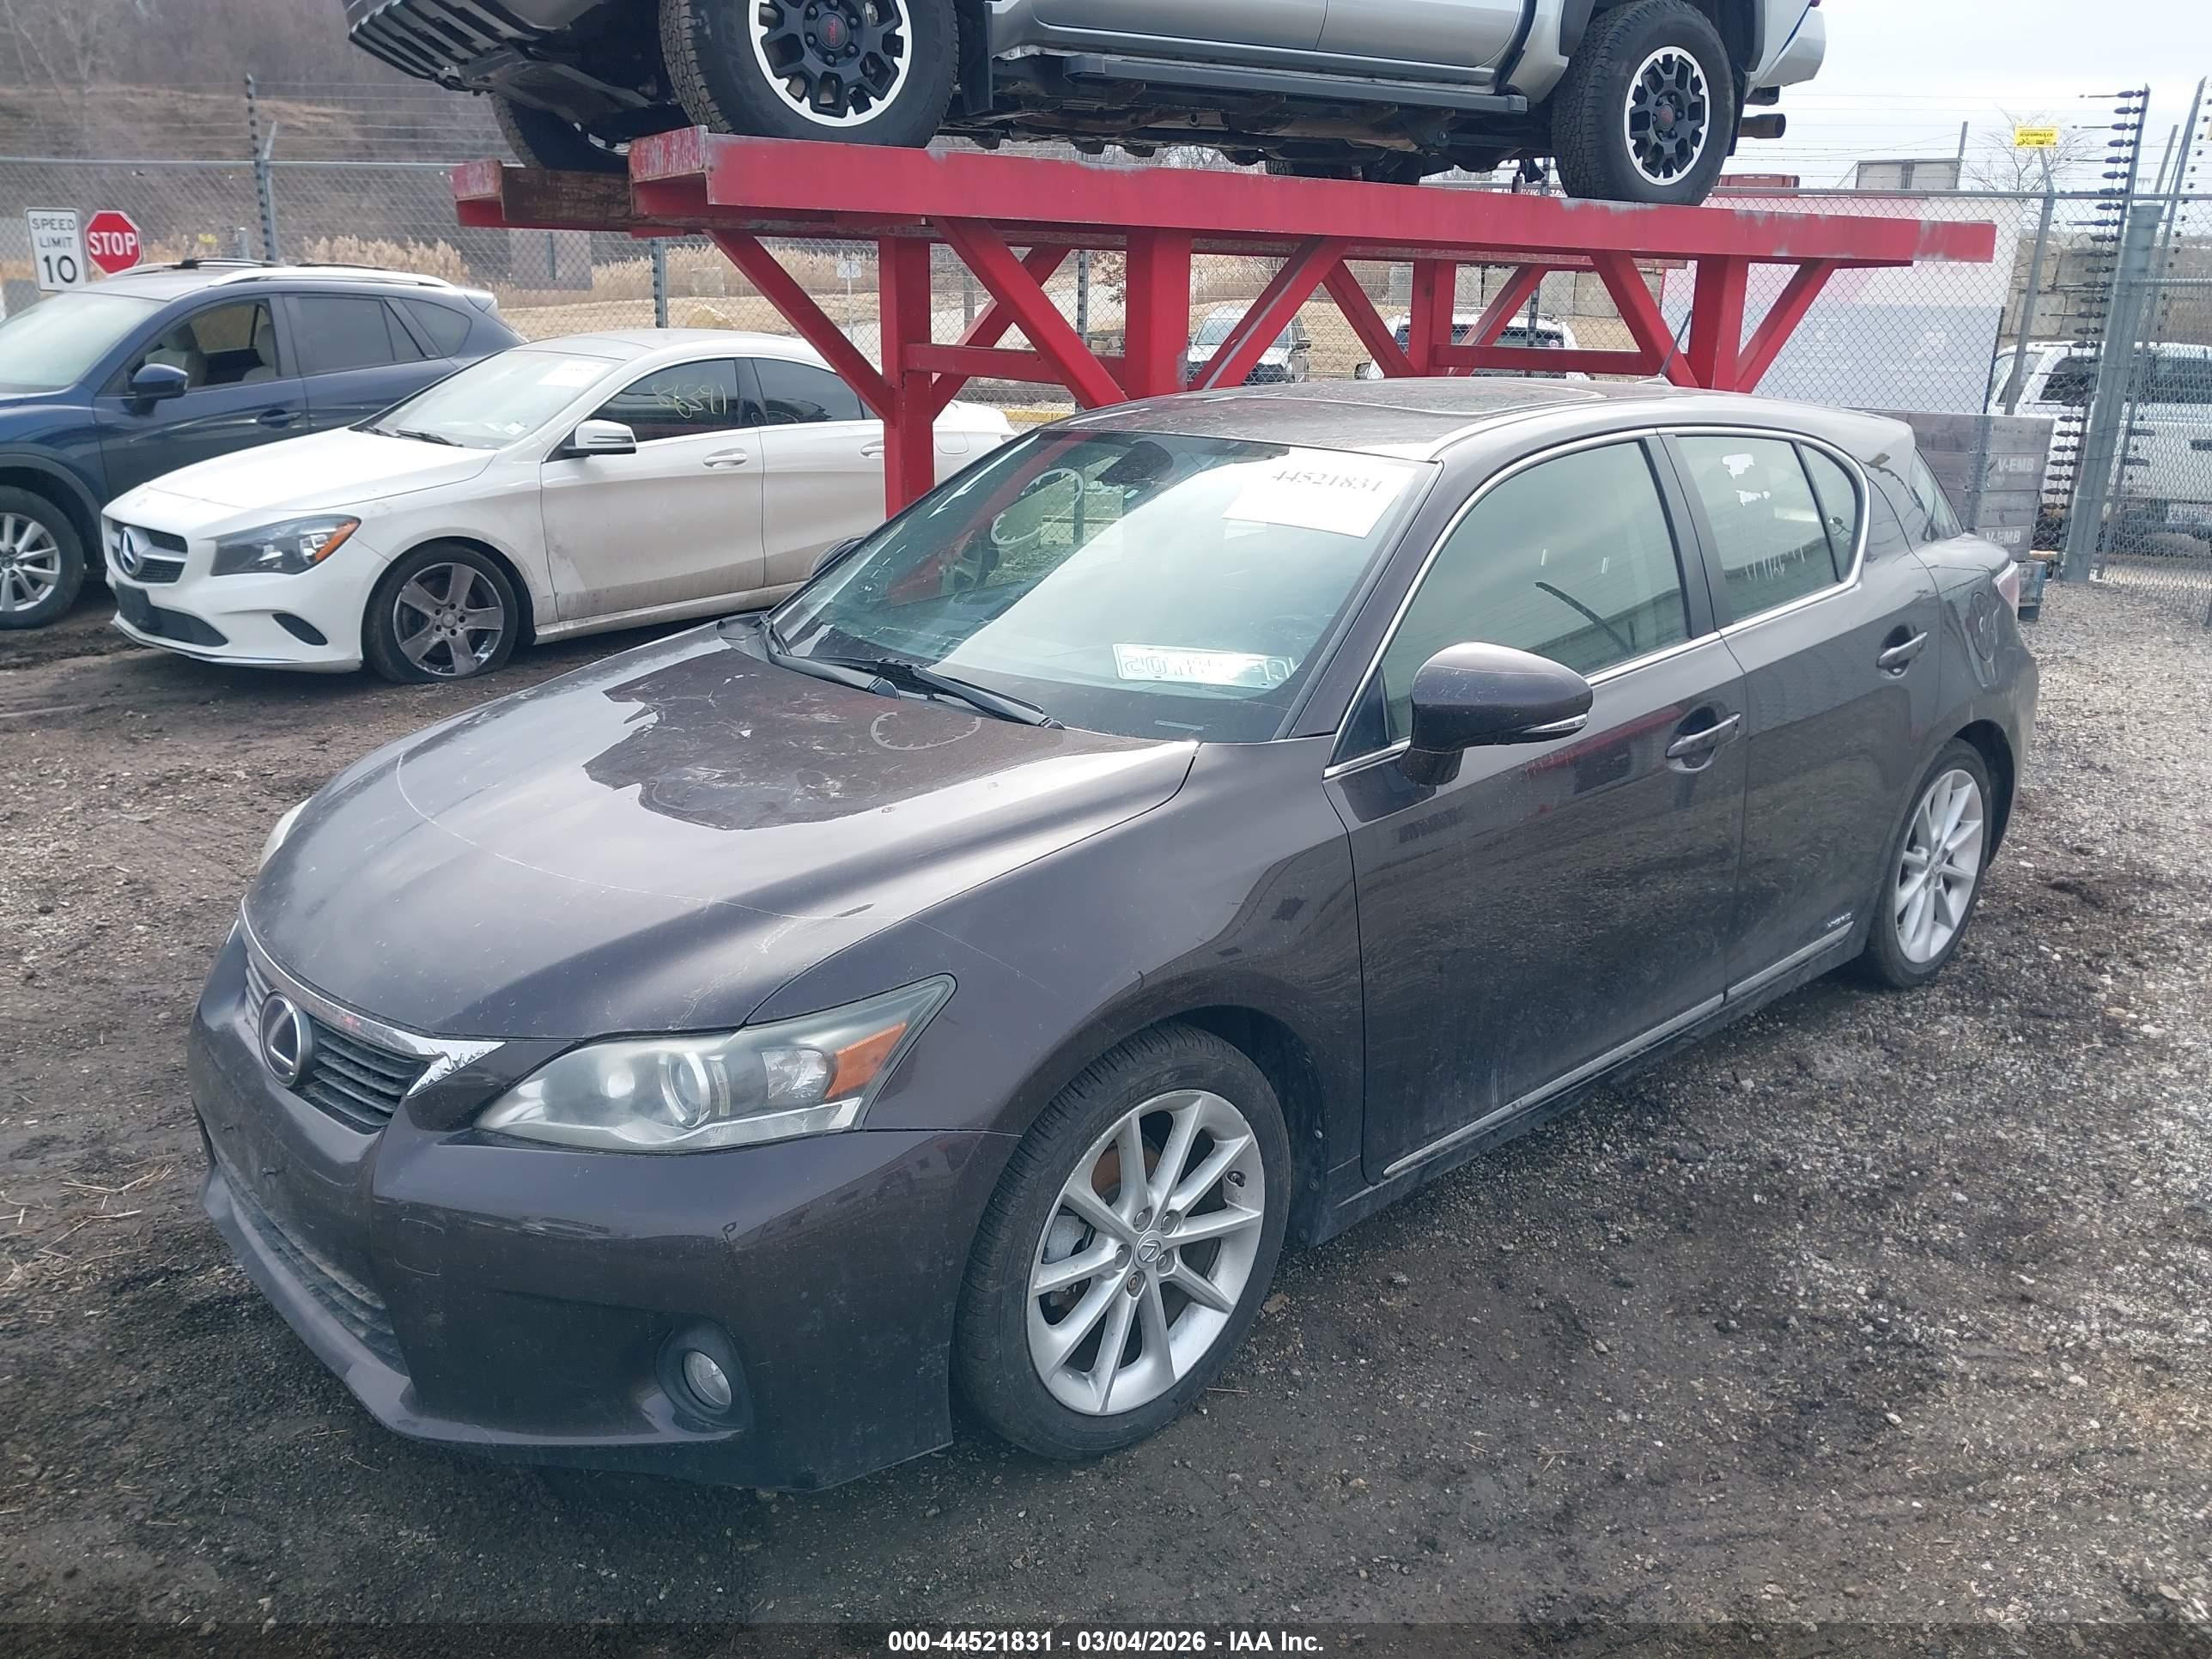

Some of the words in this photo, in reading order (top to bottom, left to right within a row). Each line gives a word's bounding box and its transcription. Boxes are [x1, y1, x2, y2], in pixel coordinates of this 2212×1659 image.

[31, 217, 76, 231] SPEED
[39, 236, 74, 248] LIMIT
[88, 231, 137, 256] STOP
[43, 254, 77, 284] 10
[1270, 470, 1384, 493] 44521831
